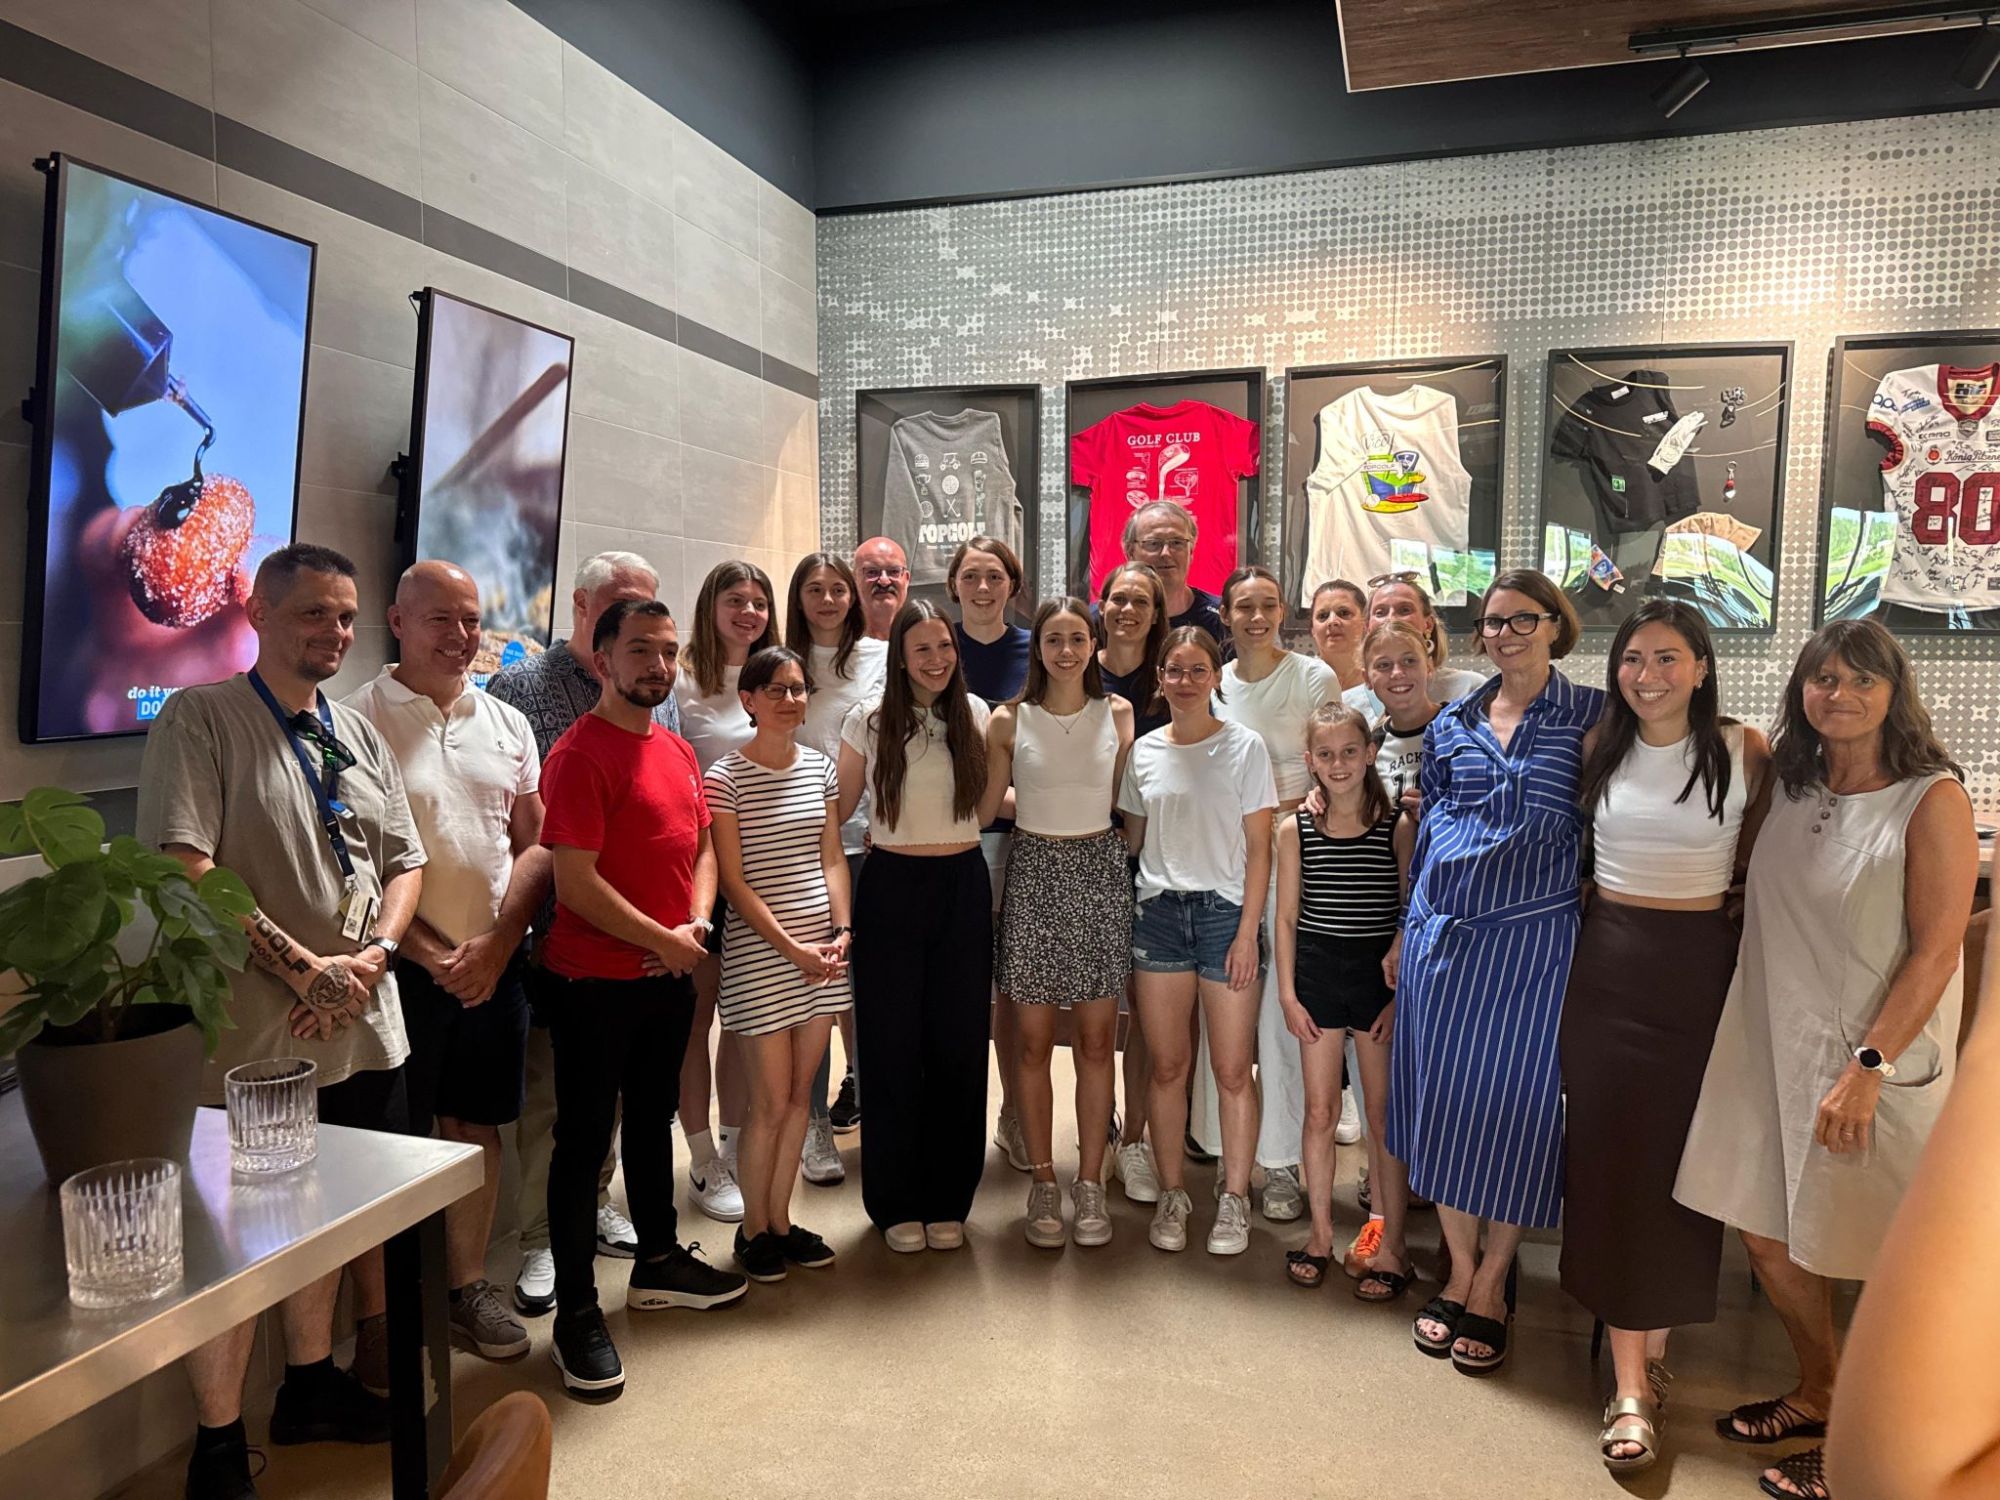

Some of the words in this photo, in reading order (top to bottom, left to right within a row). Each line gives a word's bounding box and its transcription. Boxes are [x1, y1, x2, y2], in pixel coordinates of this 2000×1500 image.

[1127, 433, 1162, 446] GOLF
[1166, 431, 1201, 443] CLUB
[1911, 472, 2000, 545] 80
[127, 686, 146, 700] do
[150, 685, 161, 698] it
[141, 700, 165, 716] DO
